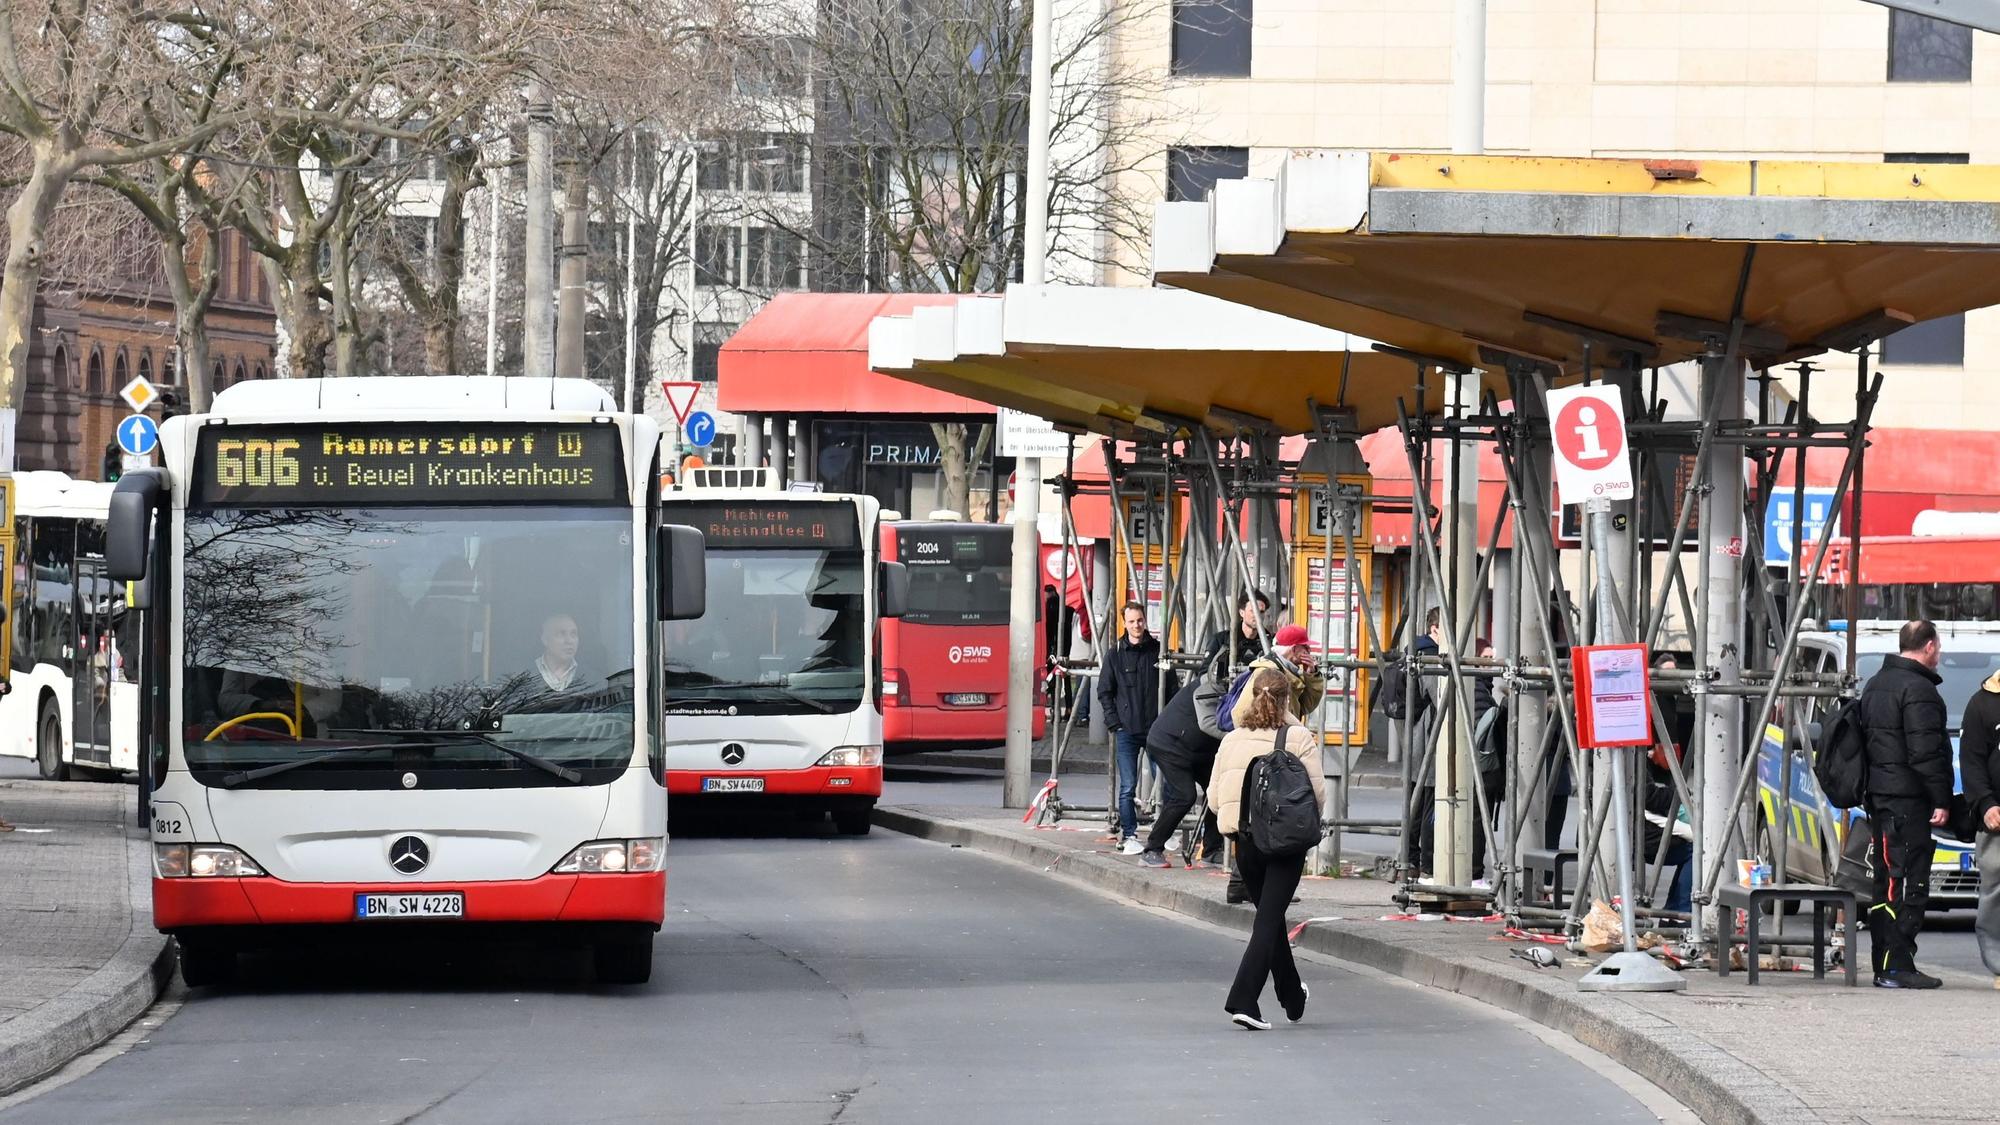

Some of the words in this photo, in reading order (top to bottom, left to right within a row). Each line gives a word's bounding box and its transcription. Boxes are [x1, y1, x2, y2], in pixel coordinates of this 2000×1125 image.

[217, 439, 300, 486] 606
[323, 432, 534, 456] Ramersdorf
[869, 444, 983, 464] PRIMA
[313, 465, 334, 486] ü.
[347, 462, 414, 486] Beuel
[428, 462, 593, 486] Krankenhaus
[709, 523, 804, 537] Rheinallee
[917, 542, 939, 554] 2004
[708, 780, 721, 790] BN
[727, 780, 739, 790] SW
[156, 819, 182, 834] 0812
[367, 898, 387, 914] BN
[399, 898, 418, 914] SW
[423, 897, 460, 914] 4228
